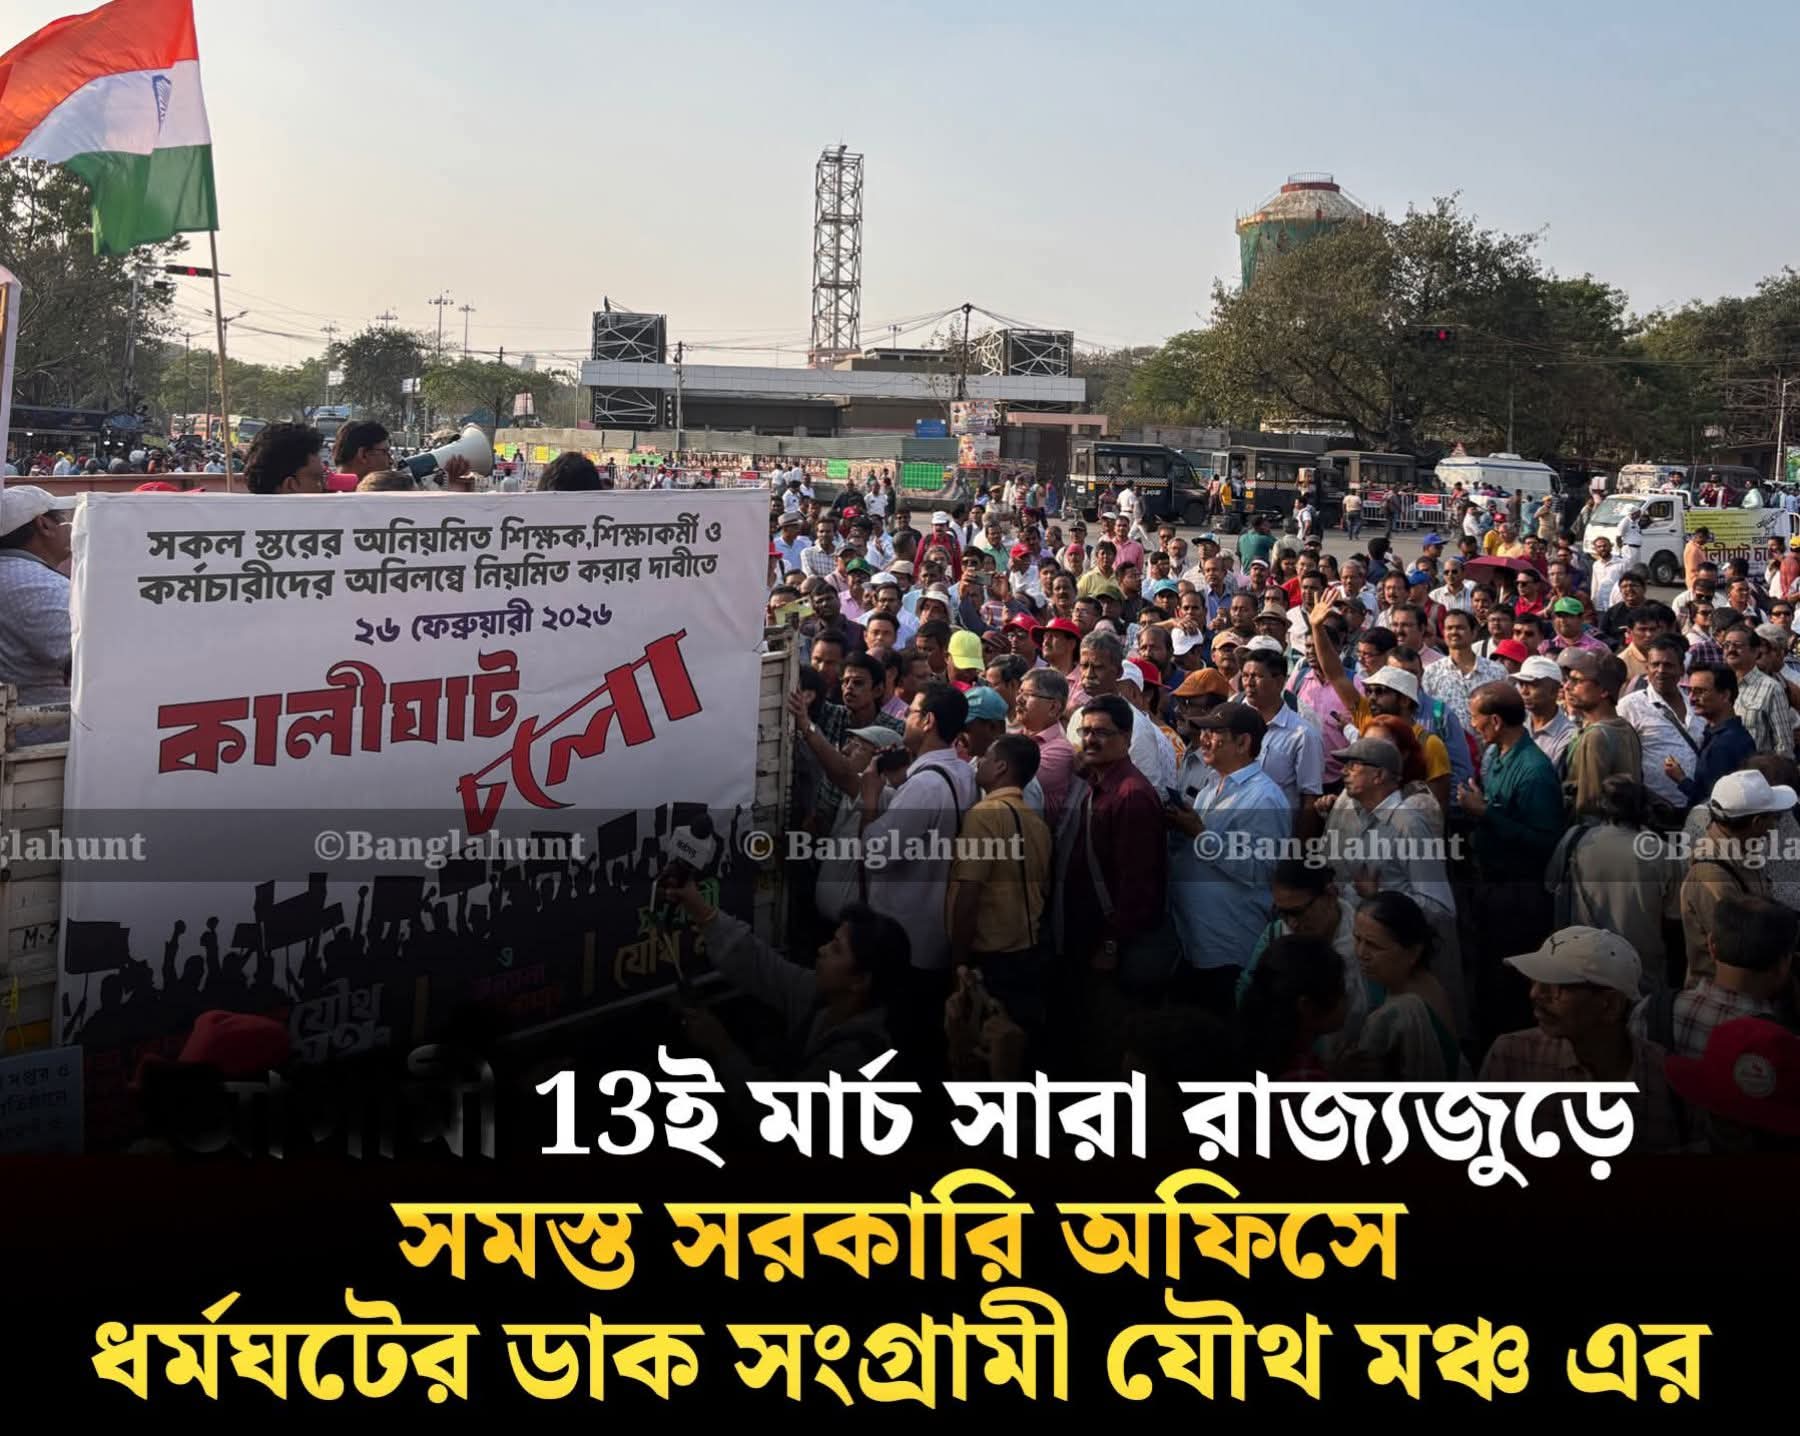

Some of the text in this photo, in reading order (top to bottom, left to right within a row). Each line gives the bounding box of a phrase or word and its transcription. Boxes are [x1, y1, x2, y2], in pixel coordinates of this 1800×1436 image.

[147, 529, 246, 560] সকল
[255, 528, 344, 560] স্তরের
[353, 516, 493, 556] অনিয়মিত
[705, 522, 722, 543] ও
[137, 546, 719, 605] কর্মচারীদের অবিলম্বে নিয়মিত করার দাবীতে
[354, 597, 613, 646] ২৬ ফেব্রুয়ারী ২০২৬
[158, 648, 520, 774] কালীঘাট
[456, 627, 703, 835] চলো
